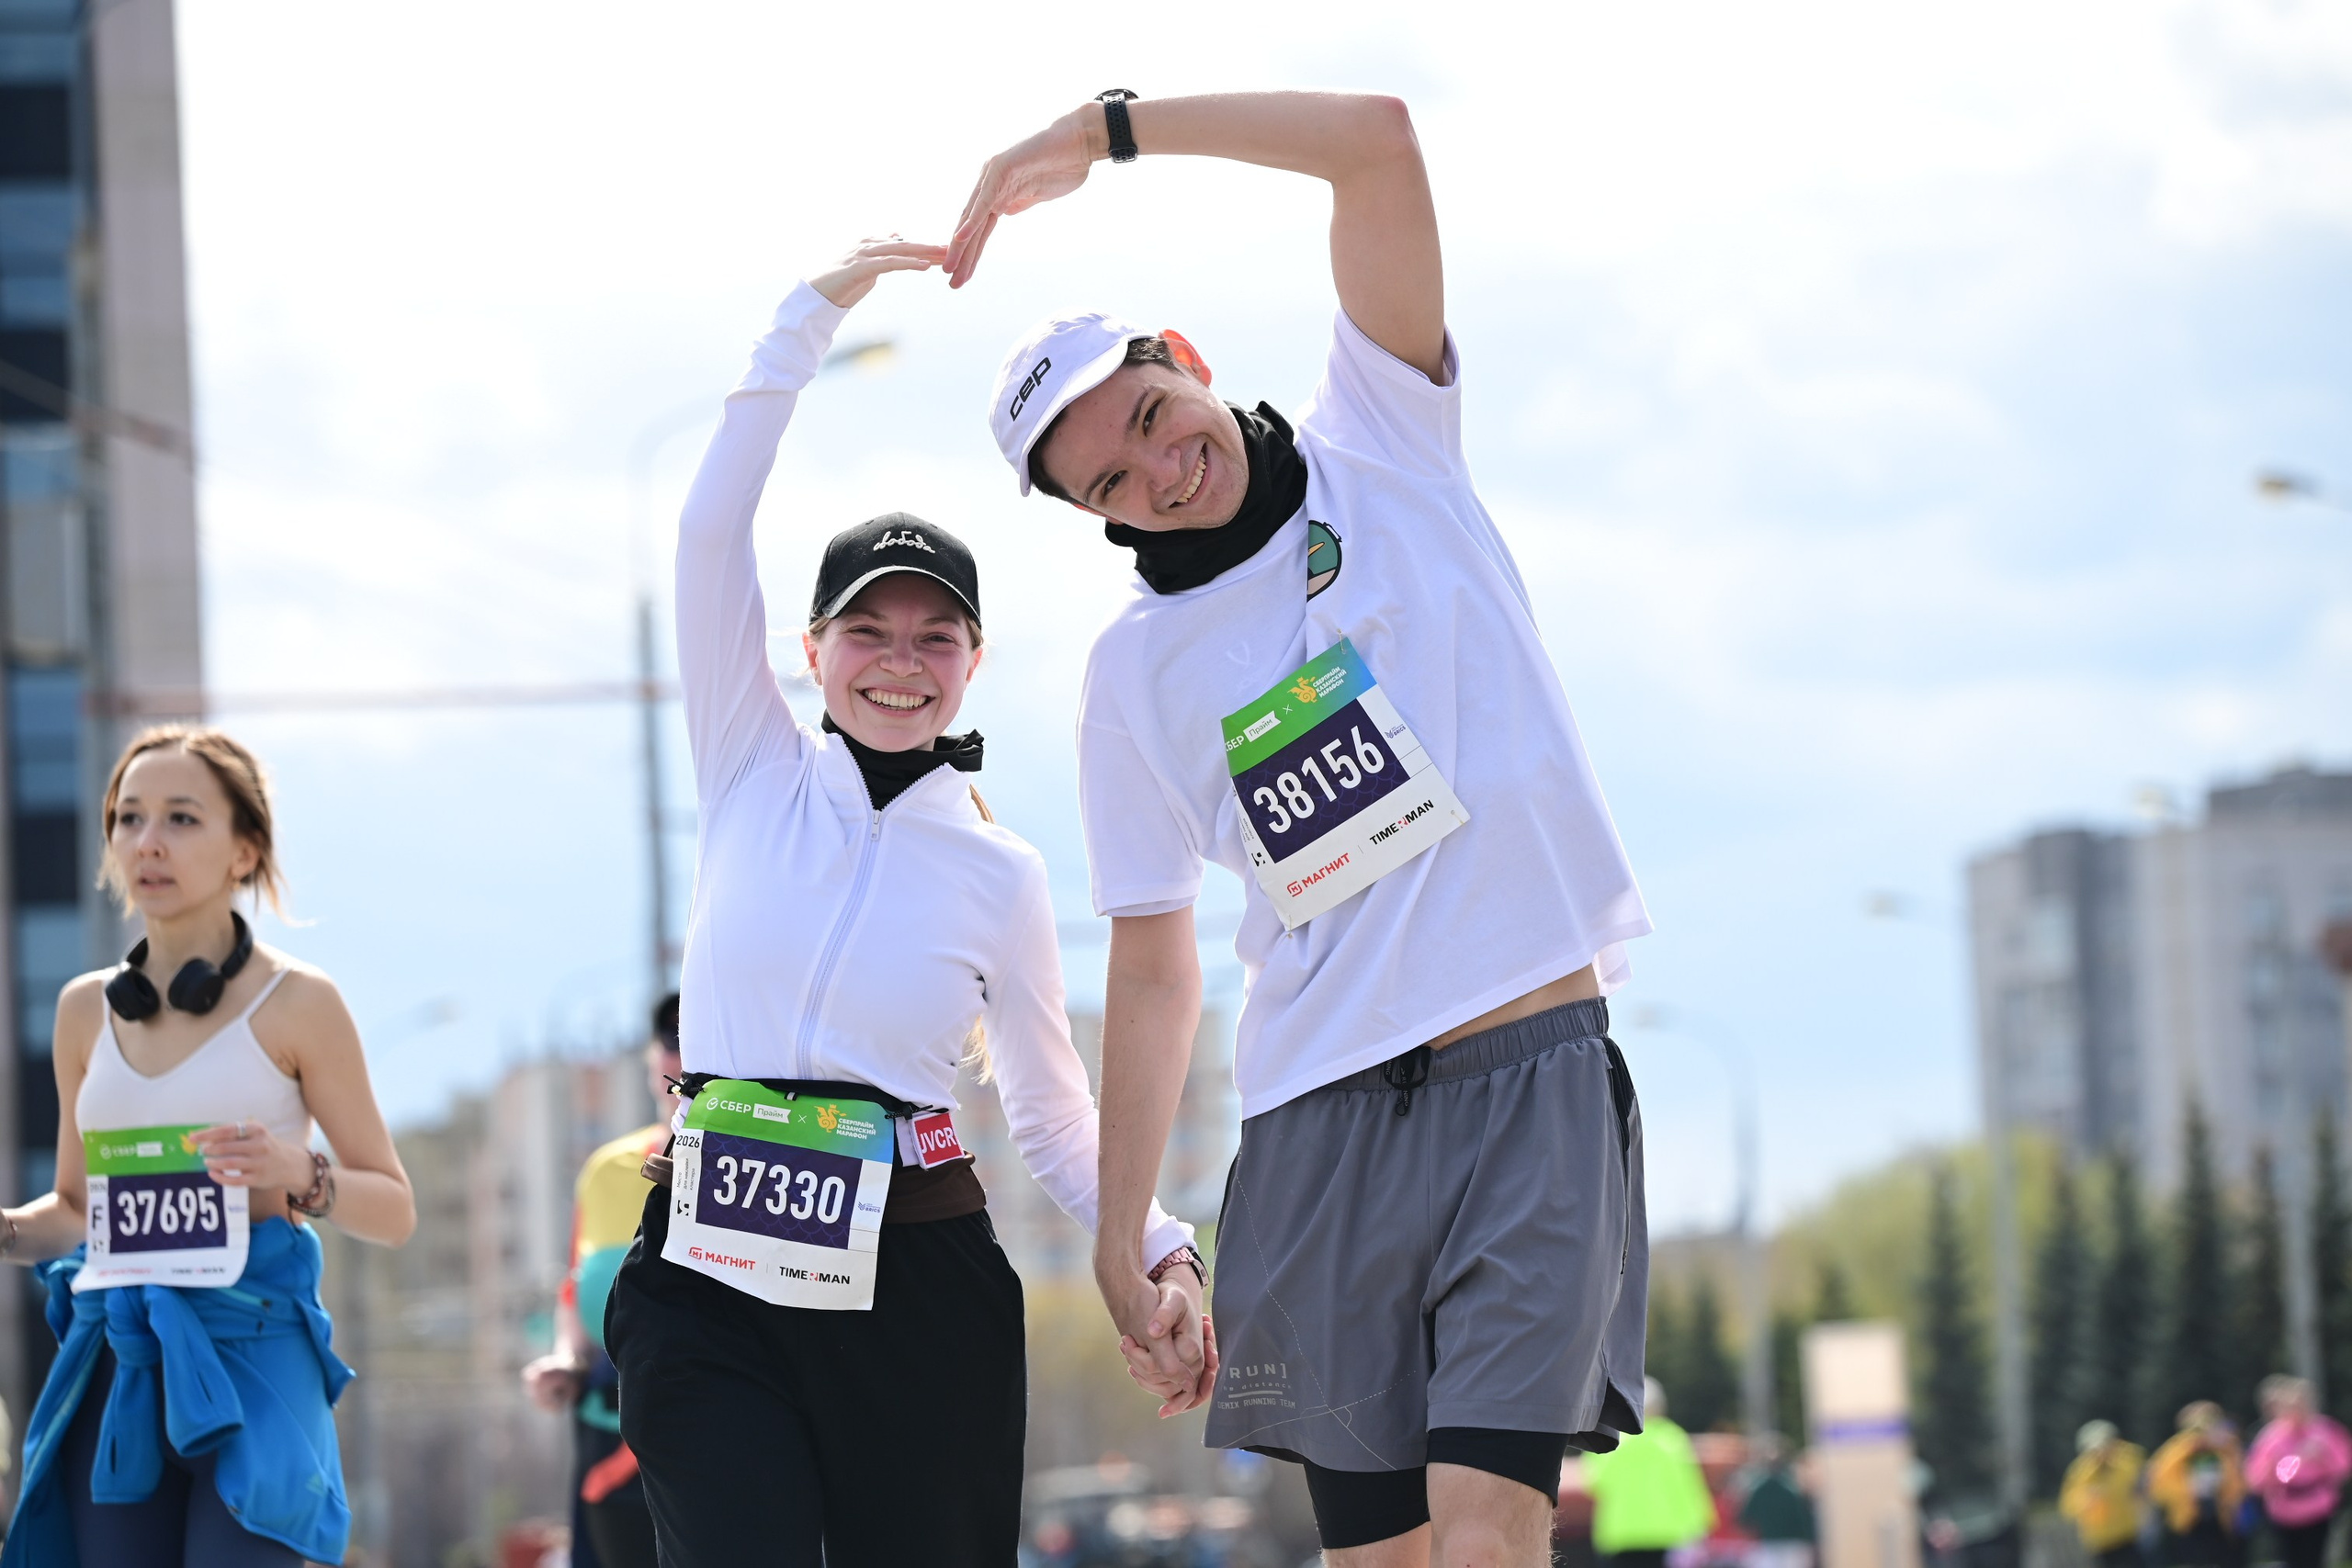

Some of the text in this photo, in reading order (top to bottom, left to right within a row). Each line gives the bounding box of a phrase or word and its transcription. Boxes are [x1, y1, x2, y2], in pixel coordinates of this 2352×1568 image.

[1315, 669, 1347, 694] КАЗАНСКИЙ
[1318, 678, 1344, 698] МАРАФОН
[1249, 718, 1273, 737] Прайм
[1253, 726, 1385, 834] 38156
[1302, 852, 1351, 888] МАГНИТ
[720, 1100, 784, 1119] СБЕР Прайм
[836, 1129, 867, 1140] МАРАФОН
[837, 1123, 876, 1136] КАЗАНСКИЙ
[676, 1135, 700, 1148] 2026
[713, 1155, 846, 1224] 37330
[93, 1205, 103, 1230] F
[117, 1187, 220, 1236] 37695
[705, 1251, 756, 1270] МАГНИТ
[1243, 1397, 1276, 1407] RUNNING
[1280, 1399, 1295, 1409] TEAM
